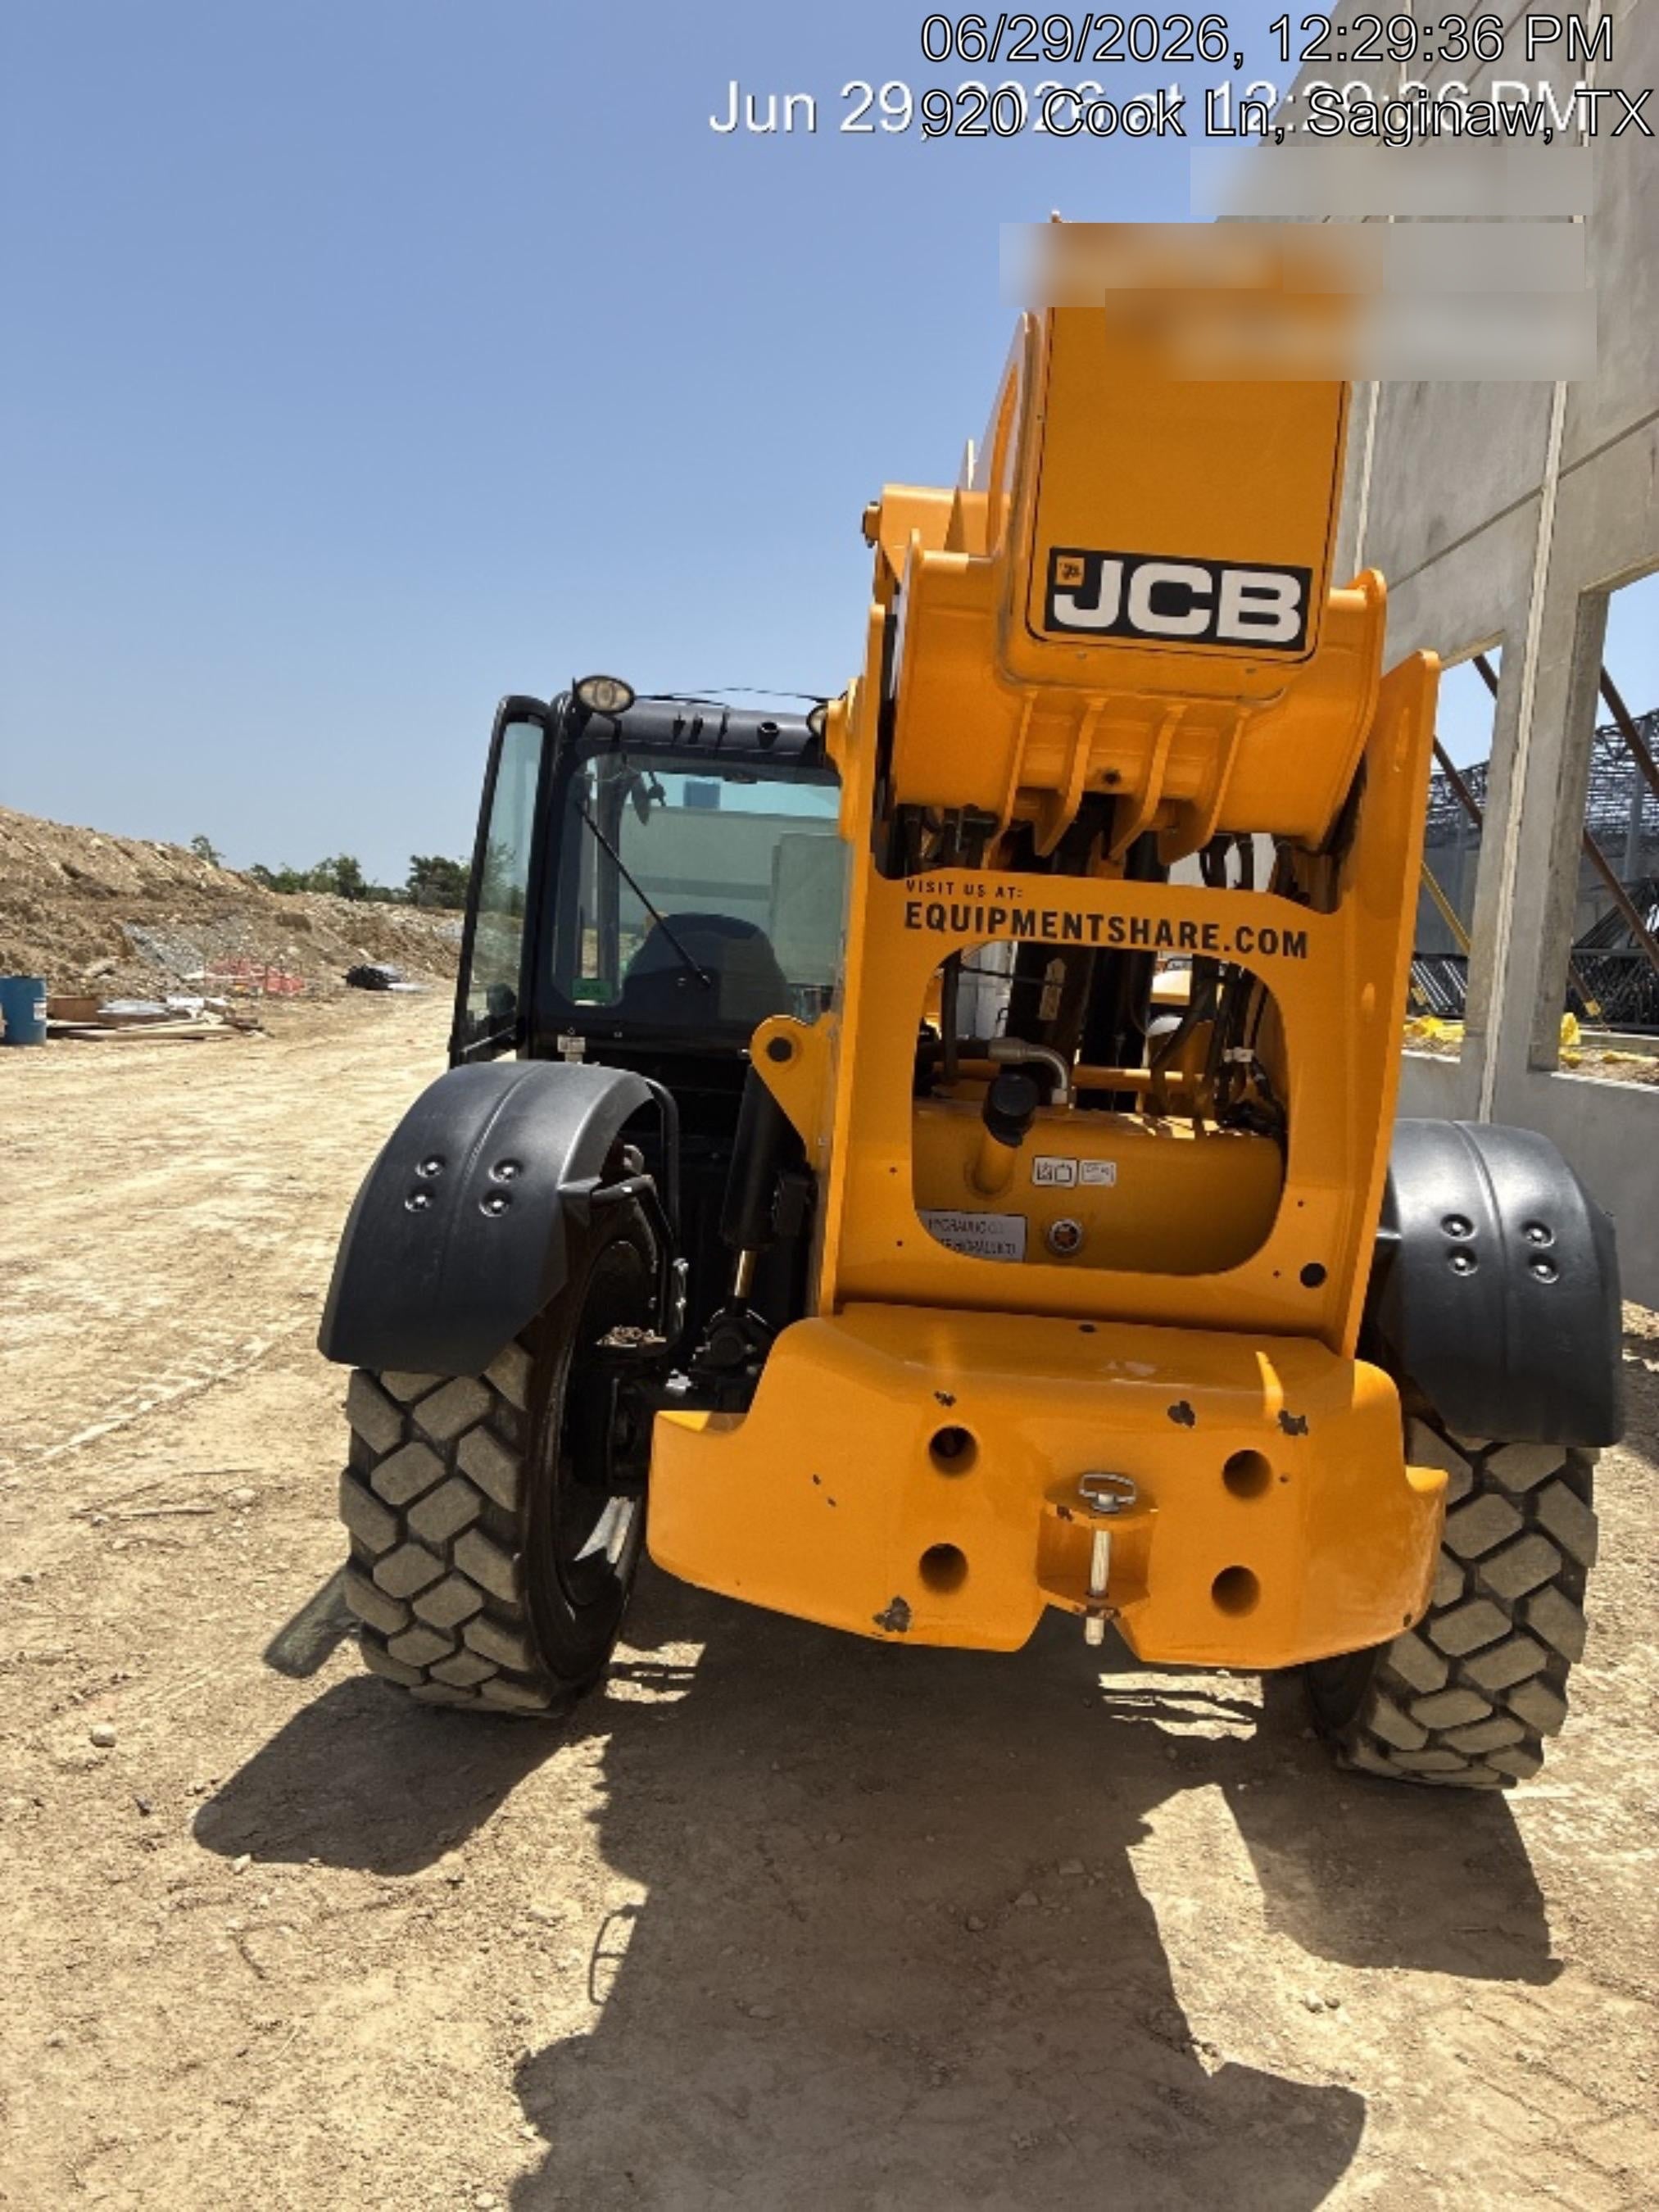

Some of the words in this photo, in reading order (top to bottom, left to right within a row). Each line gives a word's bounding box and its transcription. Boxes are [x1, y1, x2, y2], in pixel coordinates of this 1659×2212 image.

[1053, 559, 1303, 642] JCB
[906, 879, 954, 895] VISIT
[963, 883, 986, 898] US
[995, 886, 1023, 900] AT:
[904, 901, 1308, 959] EQUIPMENTSHARE.COM
